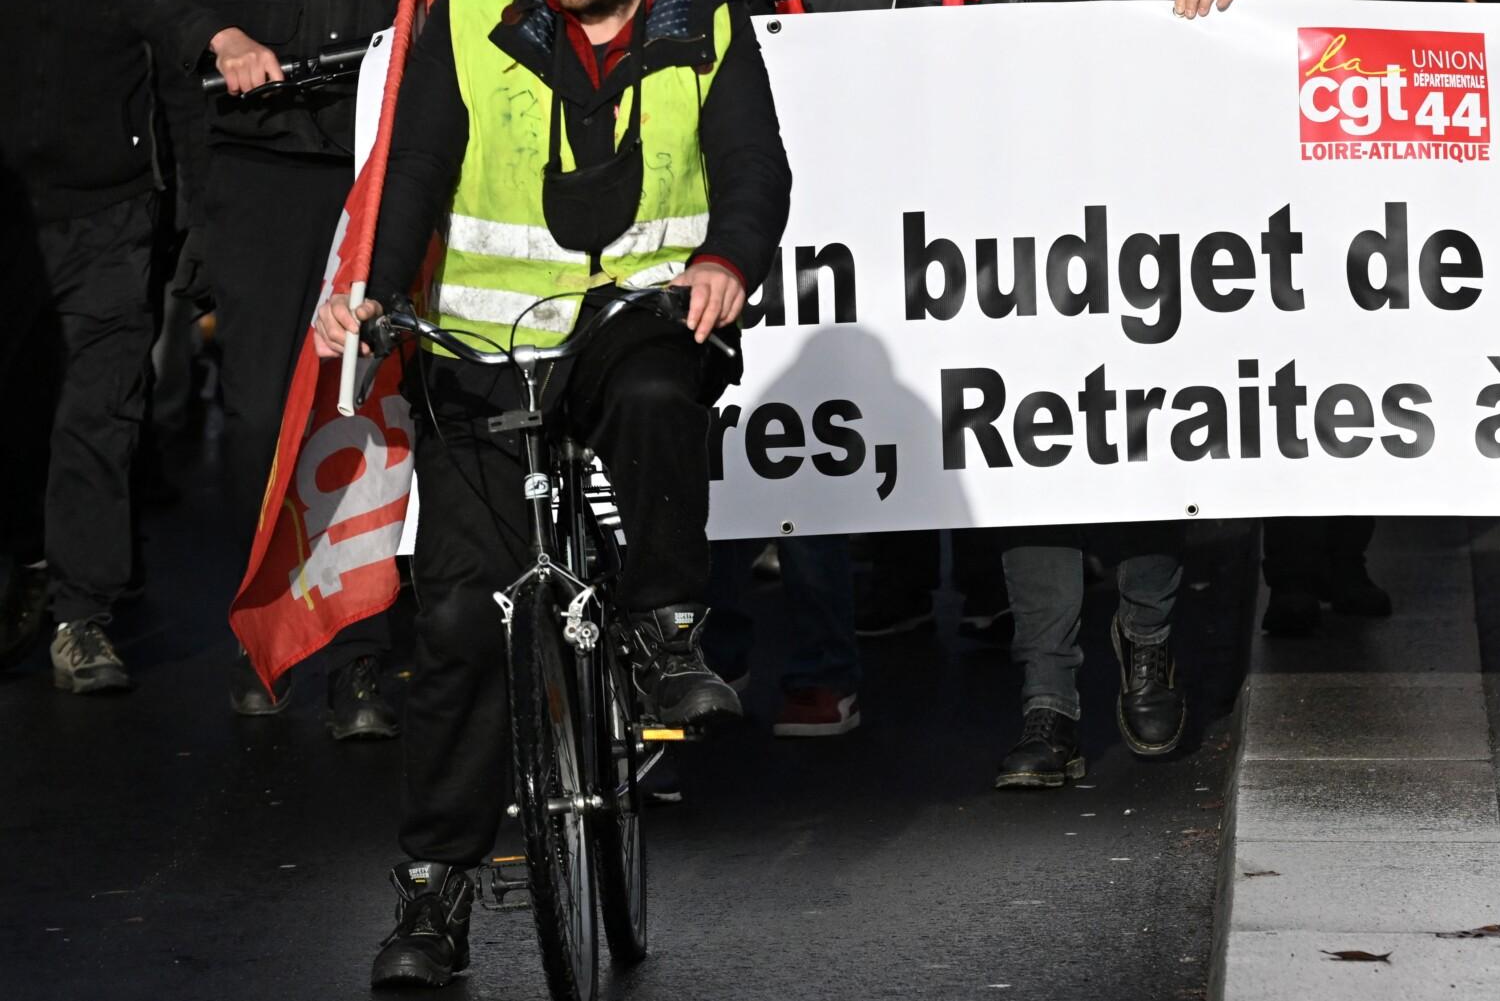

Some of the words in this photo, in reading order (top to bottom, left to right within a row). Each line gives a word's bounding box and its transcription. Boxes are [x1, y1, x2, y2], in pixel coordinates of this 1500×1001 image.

[1305, 33, 1407, 77] la
[1411, 48, 1485, 71] UNION
[1299, 63, 1409, 136] cgt
[1413, 70, 1486, 89] DÉPARTEMENTALE
[1414, 91, 1488, 137] 44
[1300, 142, 1491, 163] LOIRE-ATLANTIQUE
[903, 203, 1305, 345] budget
[1347, 202, 1484, 311] de
[708, 399, 898, 501] res,
[941, 359, 1434, 471] Retraites
